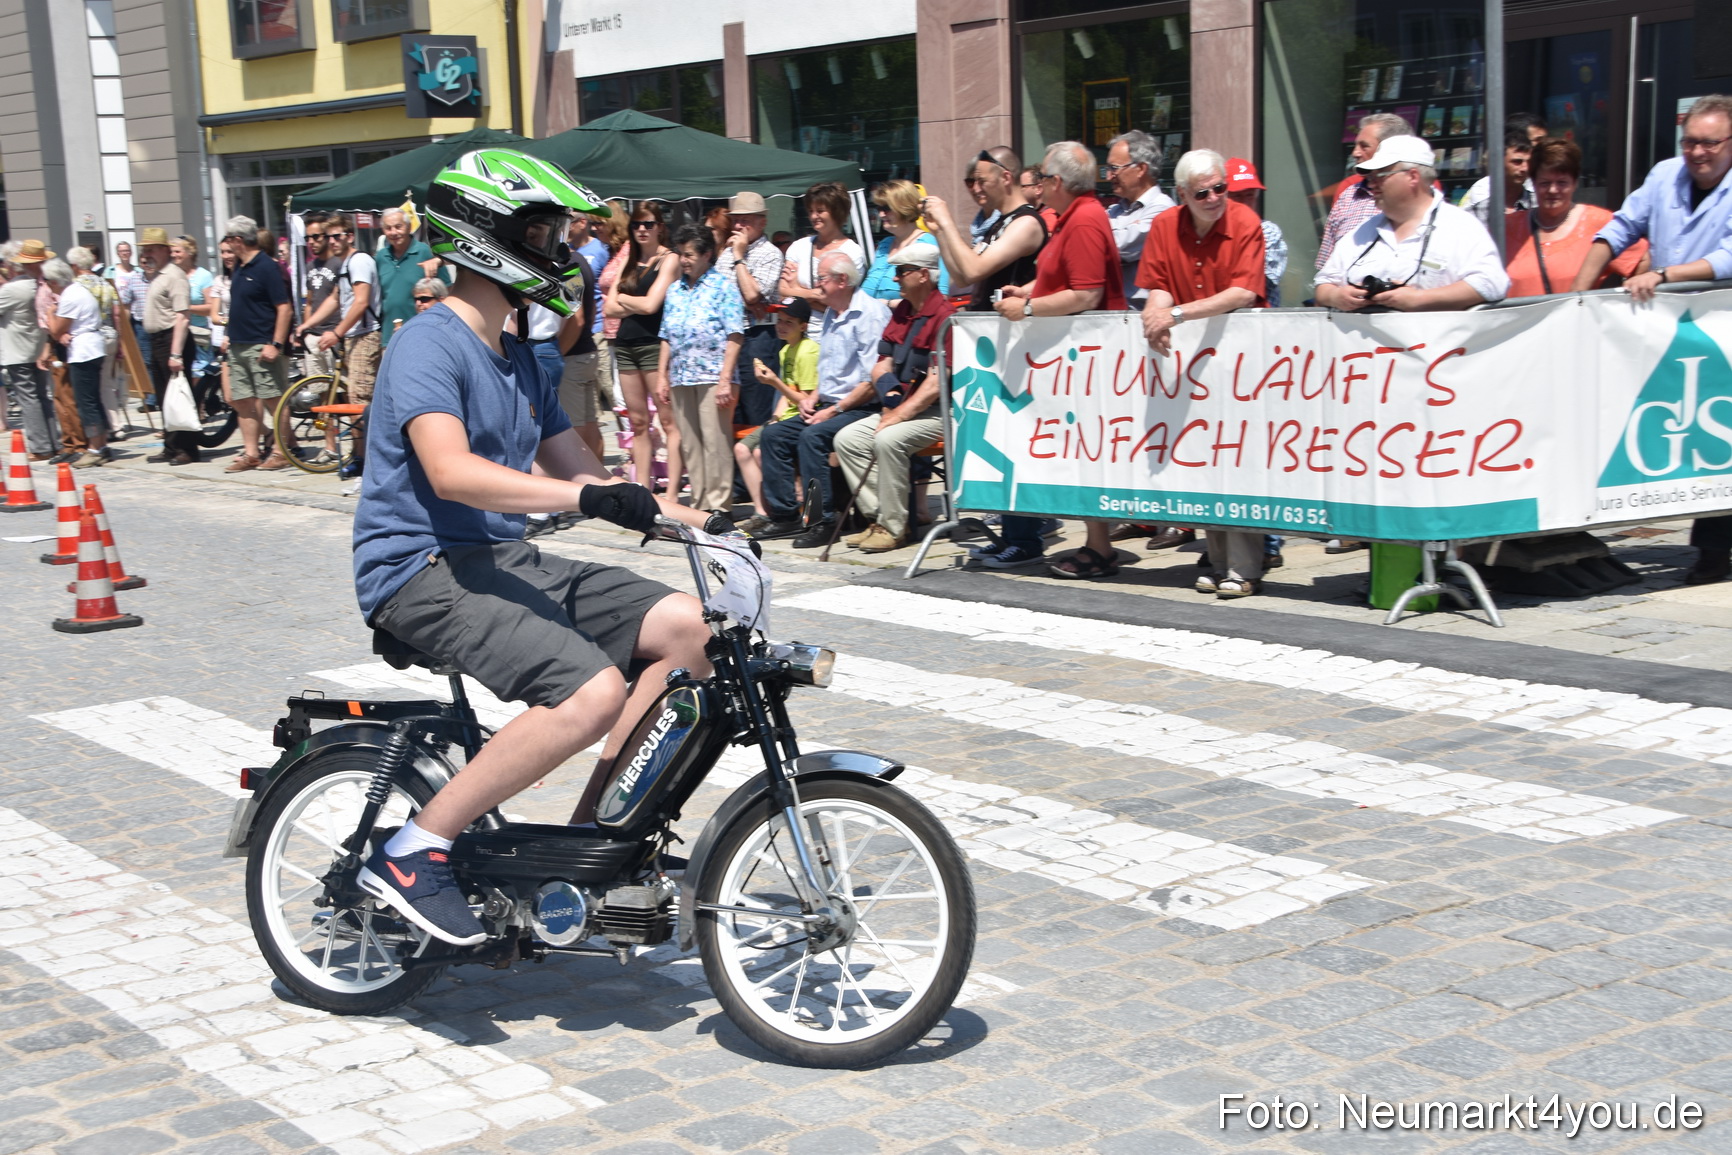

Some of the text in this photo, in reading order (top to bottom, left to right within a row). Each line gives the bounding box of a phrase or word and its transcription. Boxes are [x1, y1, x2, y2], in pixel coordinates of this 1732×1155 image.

[436, 57, 461, 91] G2
[459, 241, 496, 265] HJC
[1113, 347, 1217, 401] UNS
[1266, 418, 1535, 479] BESSER.
[1099, 495, 1210, 517] Service-Line:
[1595, 496, 1624, 512] Jura
[1628, 488, 1686, 508] Gebäude
[618, 707, 678, 793] HERCULES
